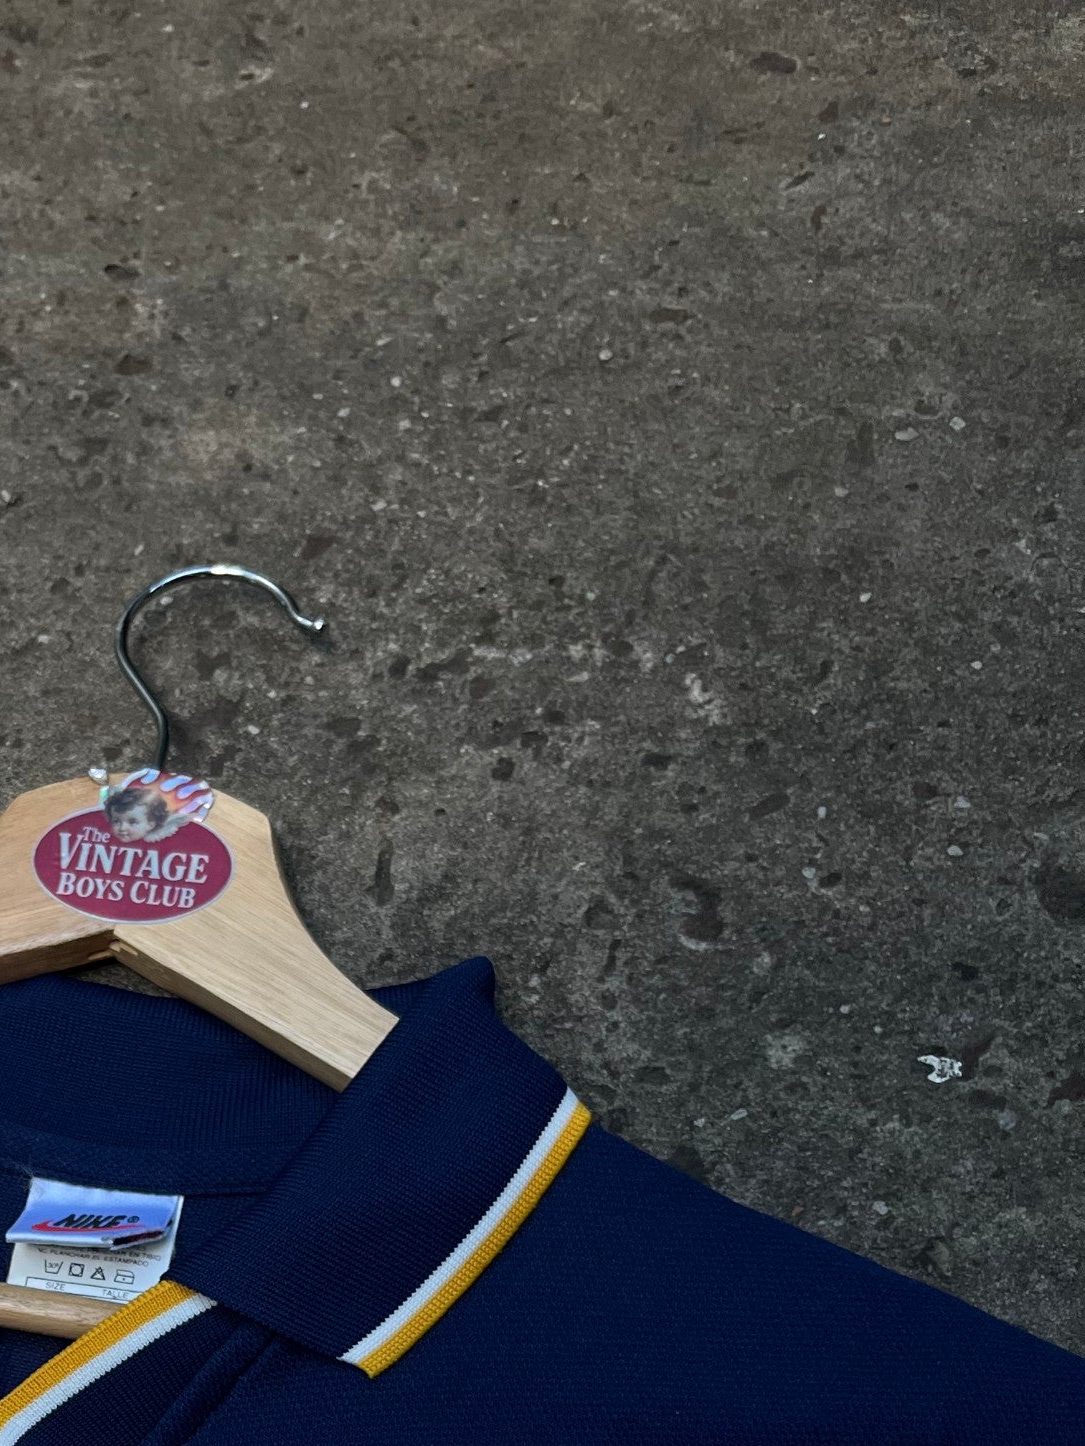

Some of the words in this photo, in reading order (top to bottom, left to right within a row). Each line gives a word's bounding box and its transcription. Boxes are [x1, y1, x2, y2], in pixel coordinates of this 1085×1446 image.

[83, 826, 111, 843] The
[58, 832, 210, 884] VINTAGE
[55, 871, 124, 902] BOYS
[130, 880, 196, 909] CLUB
[45, 1281, 66, 1292] SIZE
[102, 1288, 130, 1299] TALLE
